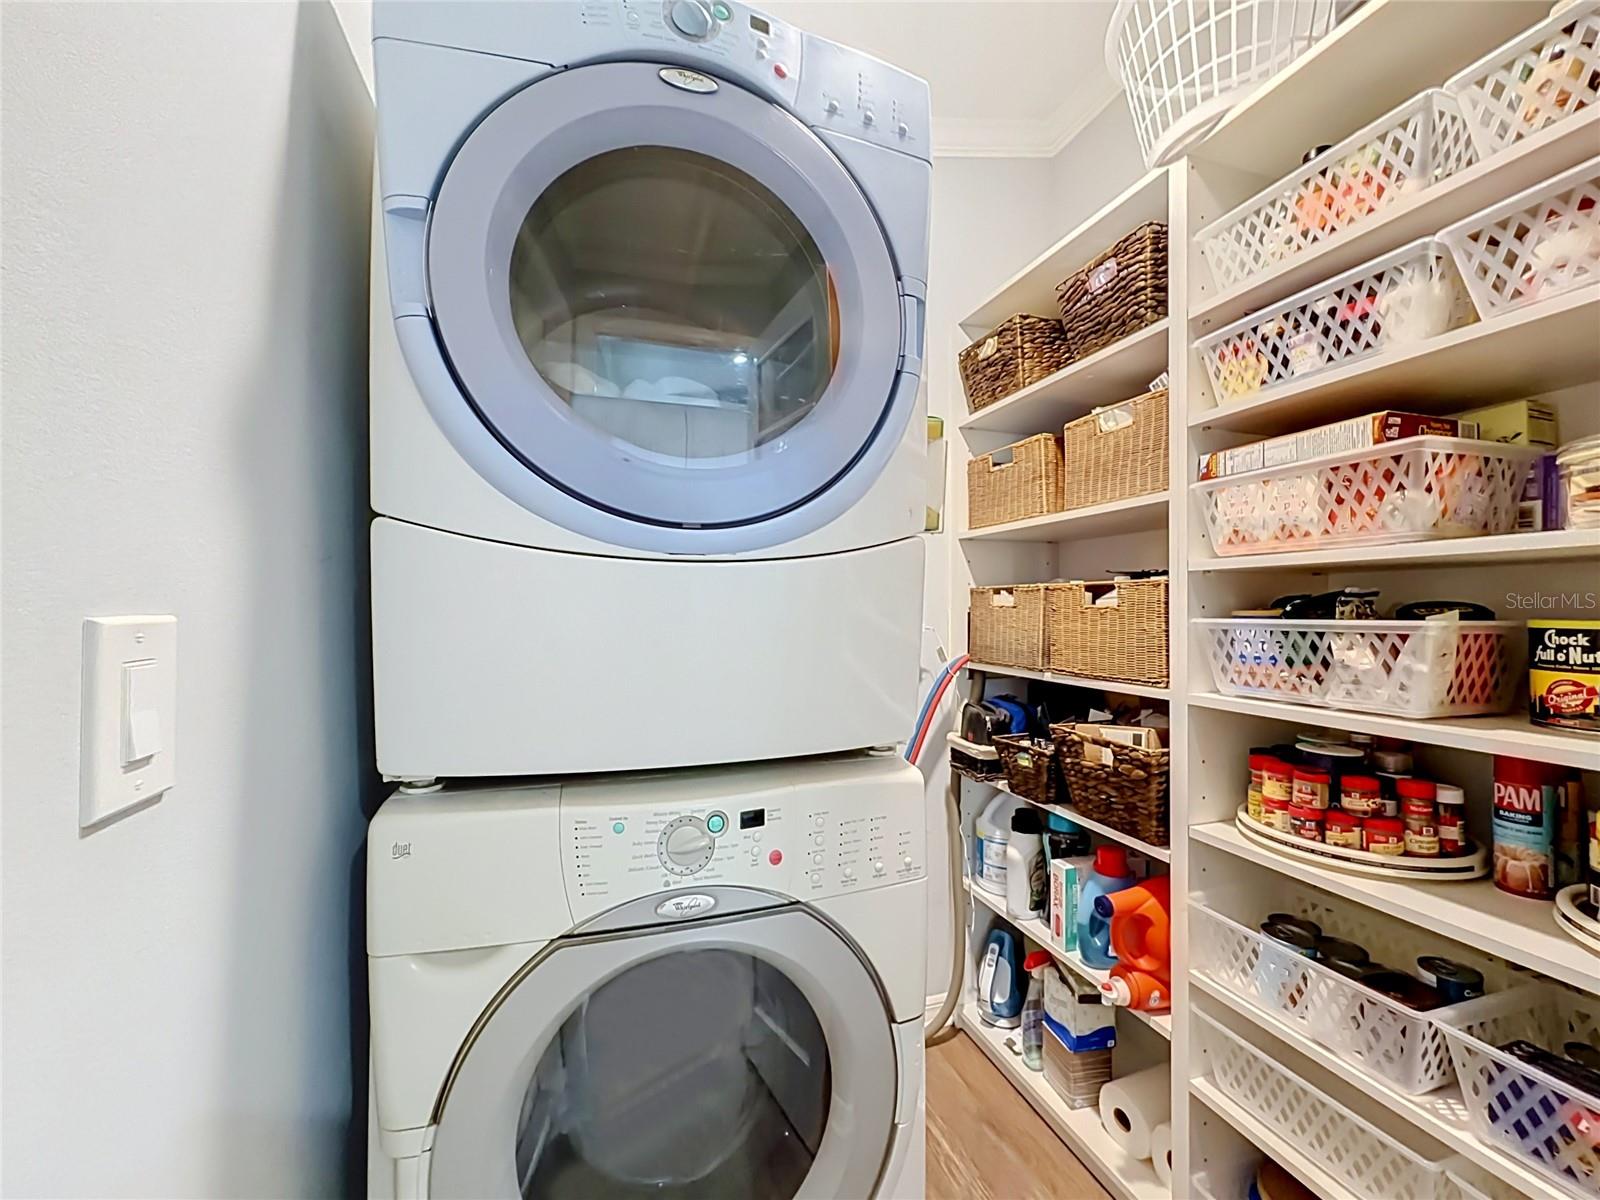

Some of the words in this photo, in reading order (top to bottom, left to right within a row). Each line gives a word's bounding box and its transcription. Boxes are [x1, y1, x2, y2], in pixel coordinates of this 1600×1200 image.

[1544, 629, 1591, 648] Chock
[1534, 645, 1555, 662] full
[1494, 782, 1541, 812] PAM
[1499, 810, 1533, 821] BAKING
